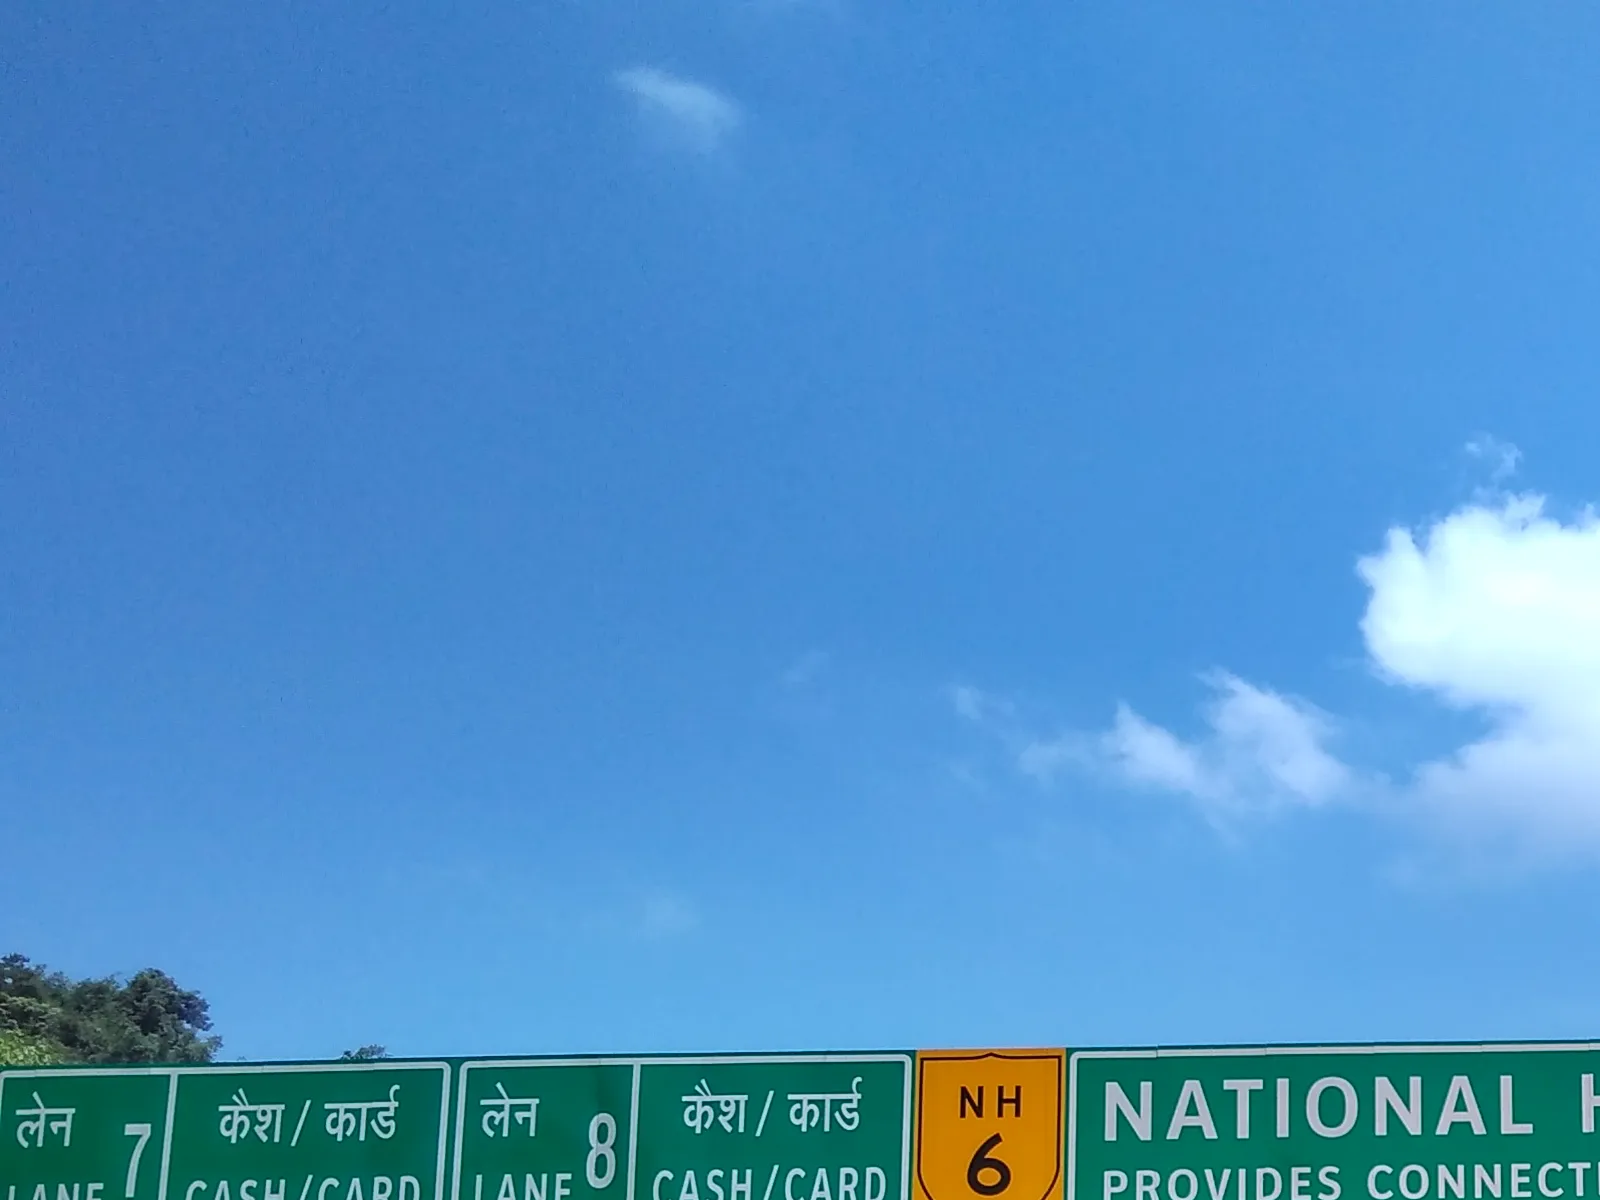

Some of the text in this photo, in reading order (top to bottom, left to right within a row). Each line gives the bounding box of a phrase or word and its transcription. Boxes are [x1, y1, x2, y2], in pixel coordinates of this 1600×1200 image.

[16, 1091, 76, 1149] लेन
[218, 1088, 286, 1144] कैश
[324, 1084, 401, 1142] कार्ड
[480, 1082, 540, 1138] लेन
[682, 1079, 749, 1134] कैश
[787, 1077, 863, 1133] कार्ड
[959, 1085, 1022, 1119] NH
[1105, 1074, 1534, 1141] NATIONAL
[124, 1123, 152, 1198] 7
[586, 1112, 617, 1189] 8
[966, 1132, 1011, 1196] 6
